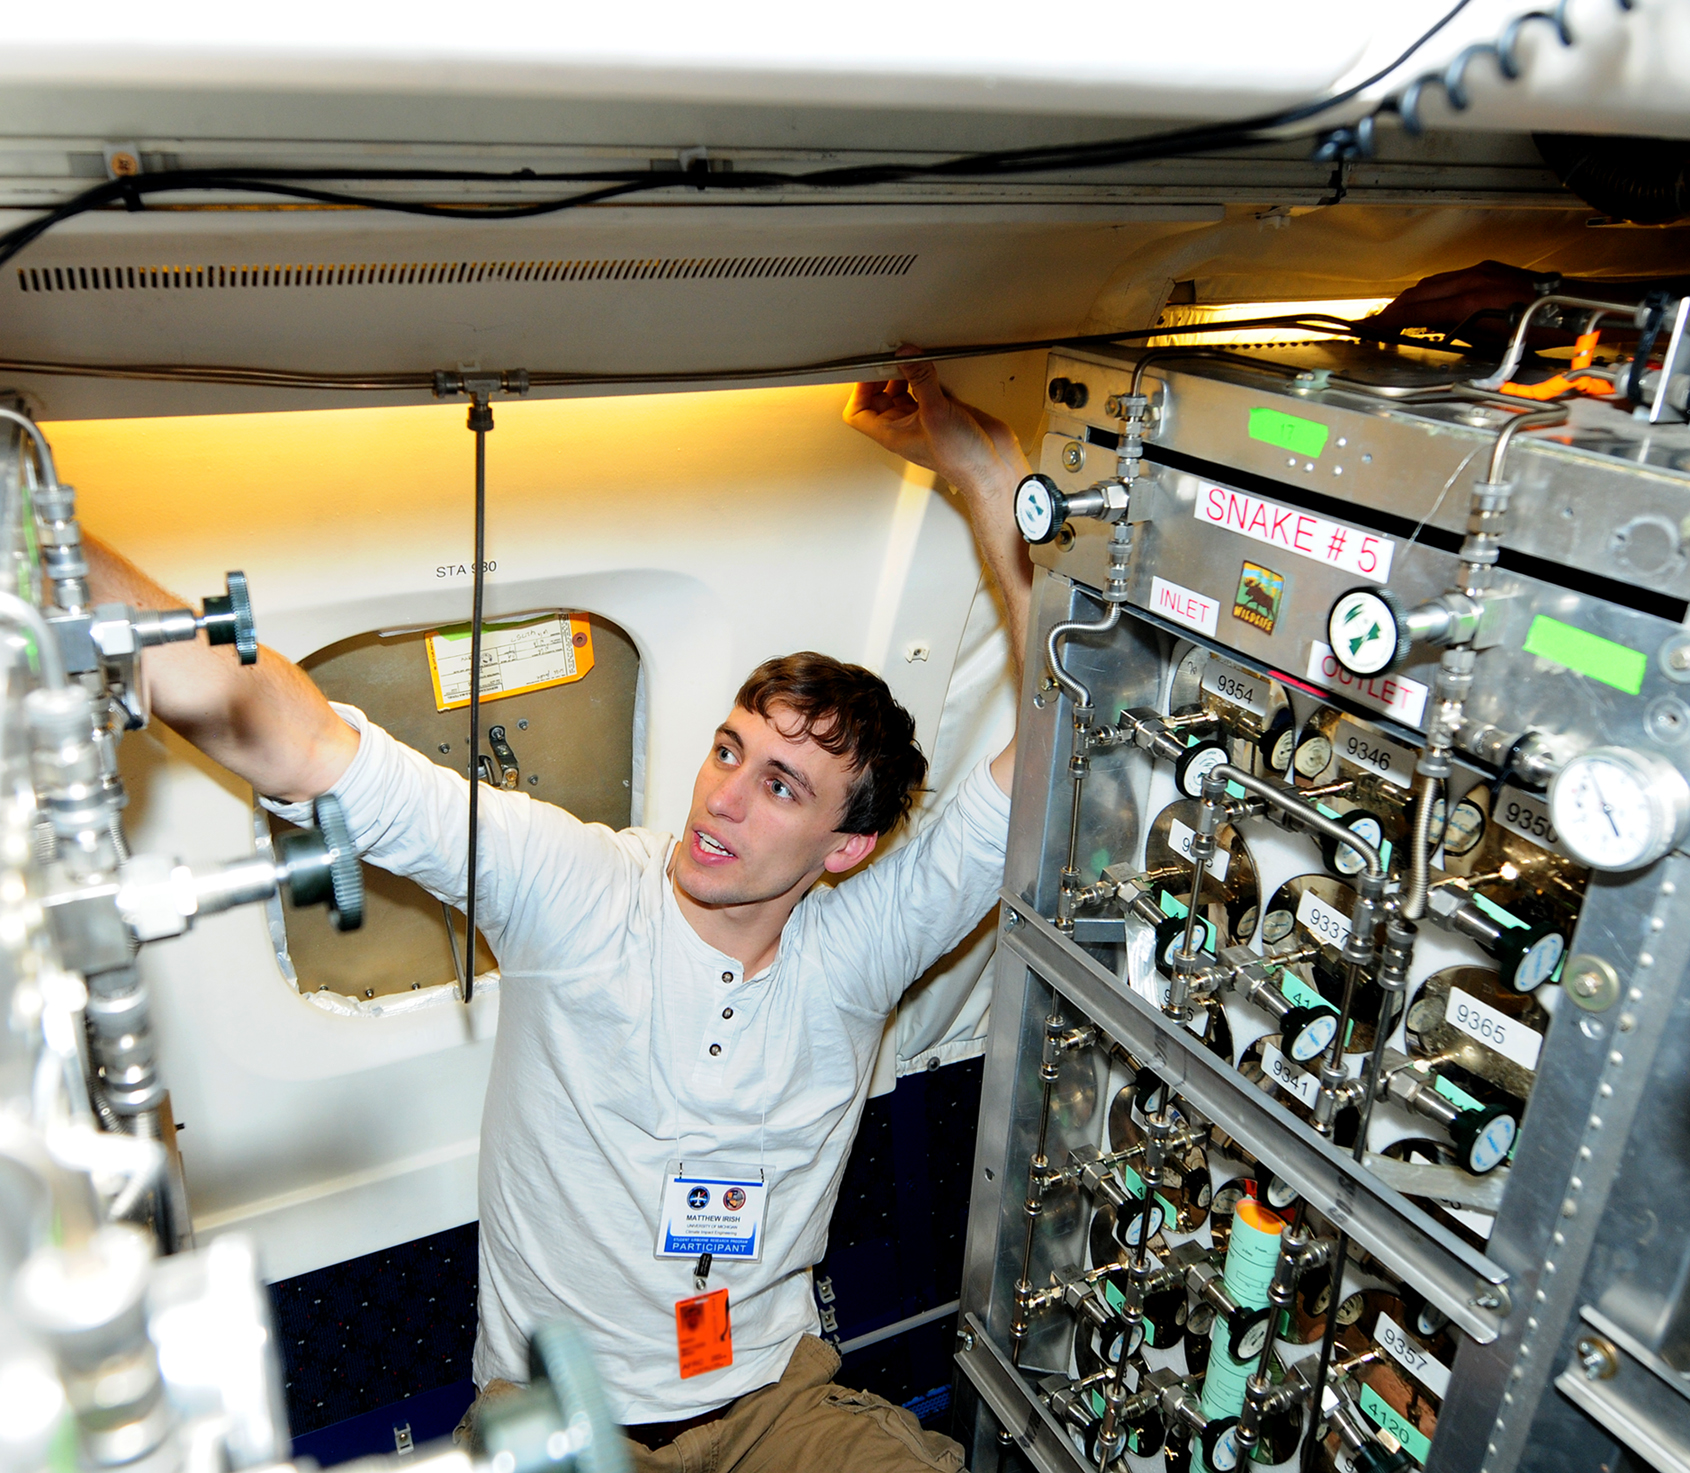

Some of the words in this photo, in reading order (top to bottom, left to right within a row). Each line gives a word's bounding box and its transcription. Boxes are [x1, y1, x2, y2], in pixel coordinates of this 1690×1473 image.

[1206, 488, 1318, 552] SNAKE
[1327, 527, 1347, 561] #
[1357, 537, 1379, 573] 5
[436, 565, 467, 578] STA
[1159, 587, 1210, 623] INLET
[1233, 605, 1275, 632] WILDLIFE
[1217, 675, 1253, 704] 9354
[1346, 736, 1391, 771] 9346
[1310, 908, 1351, 944] 9337
[1456, 1003, 1506, 1045] 9365
[1273, 1060, 1309, 1097] 9341
[686, 1214, 721, 1222] MATTHEW
[722, 1215, 741, 1223] IRISH
[672, 1242, 747, 1253] PARTICIPANT
[1383, 1328, 1427, 1371] 9357
[1368, 1403, 1410, 1445] 4120
